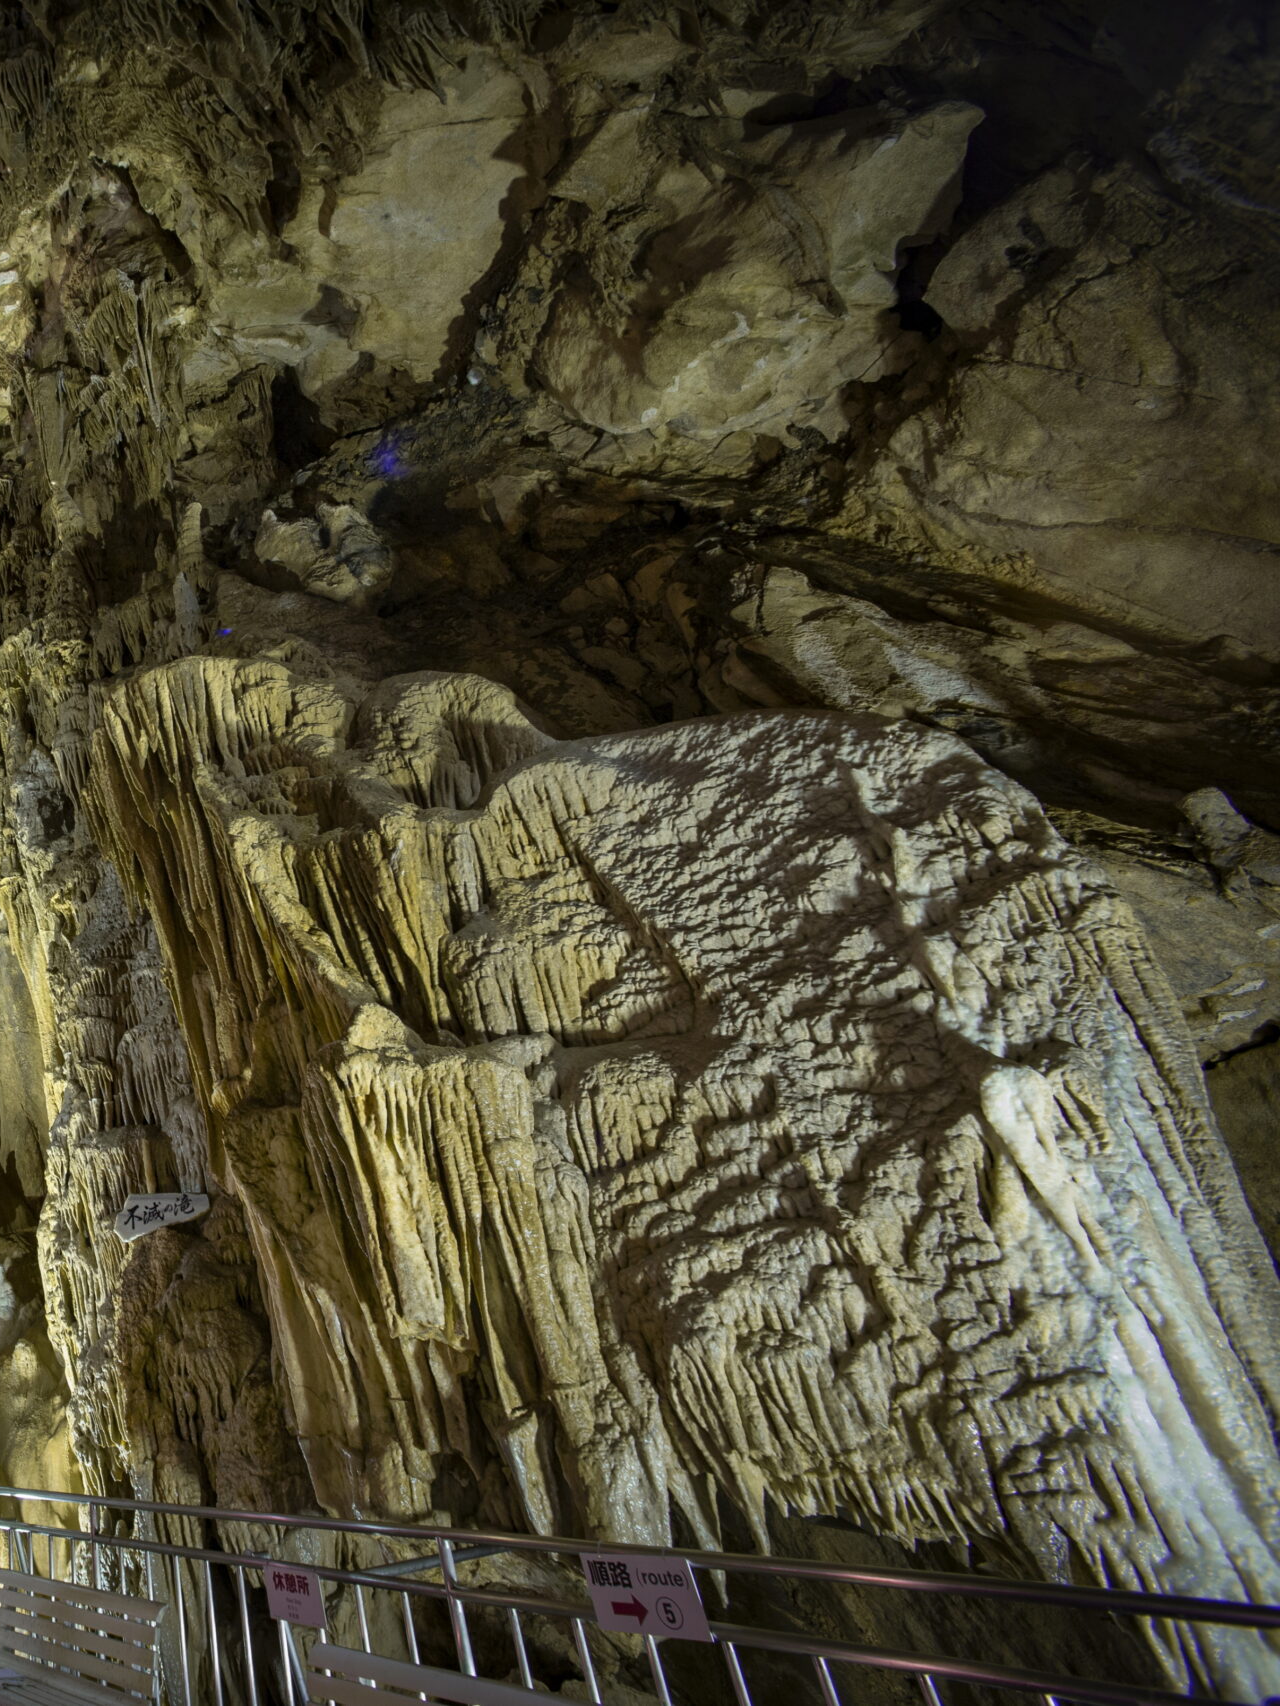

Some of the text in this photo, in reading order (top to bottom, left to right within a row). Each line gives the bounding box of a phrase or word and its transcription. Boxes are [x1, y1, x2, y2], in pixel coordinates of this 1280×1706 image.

[124, 1194, 195, 1230] 不滅の滝
[273, 1571, 310, 1596] 休憩所
[587, 1560, 633, 1589] 順路
